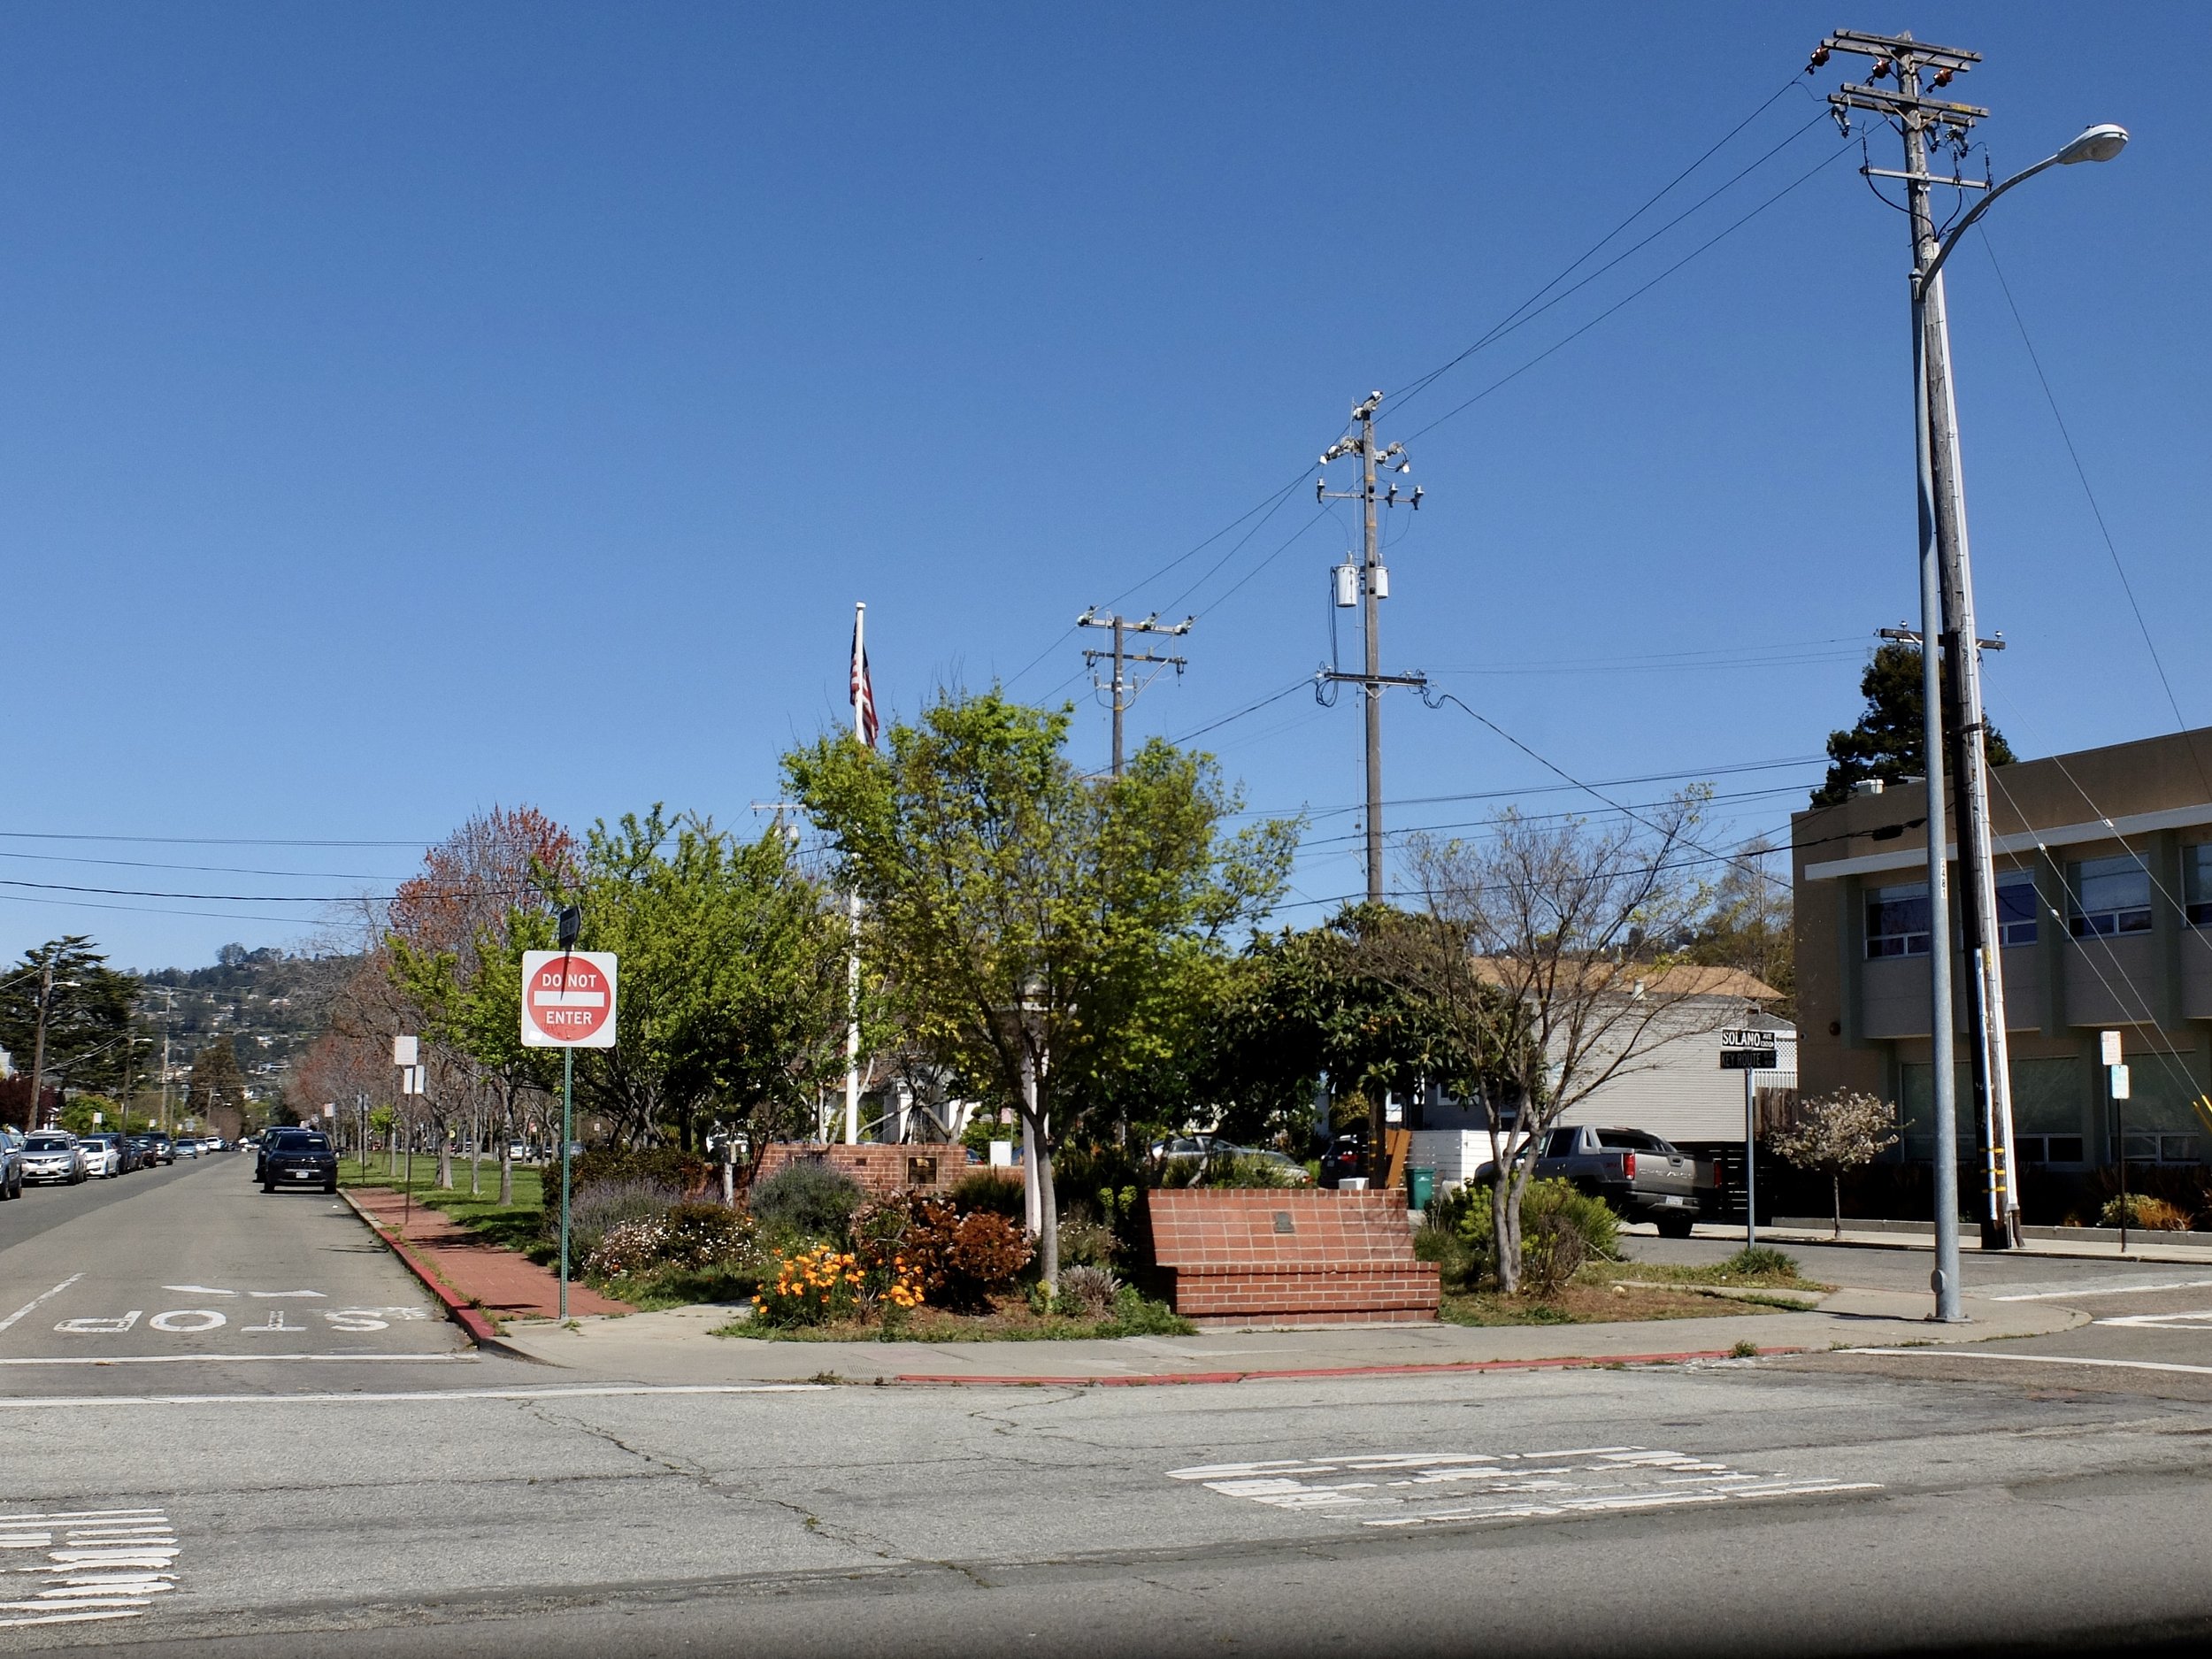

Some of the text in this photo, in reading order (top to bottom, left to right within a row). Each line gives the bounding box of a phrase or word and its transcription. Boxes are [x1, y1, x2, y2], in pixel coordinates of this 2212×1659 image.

[542, 973, 596, 987] DO NOT
[546, 1010, 592, 1025] ENTER
[1723, 1032, 1761, 1047] SOLANO
[1722, 1053, 1735, 1066] KEY
[1737, 1052, 1762, 1066] ROUTE
[54, 1310, 390, 1333] STOP
